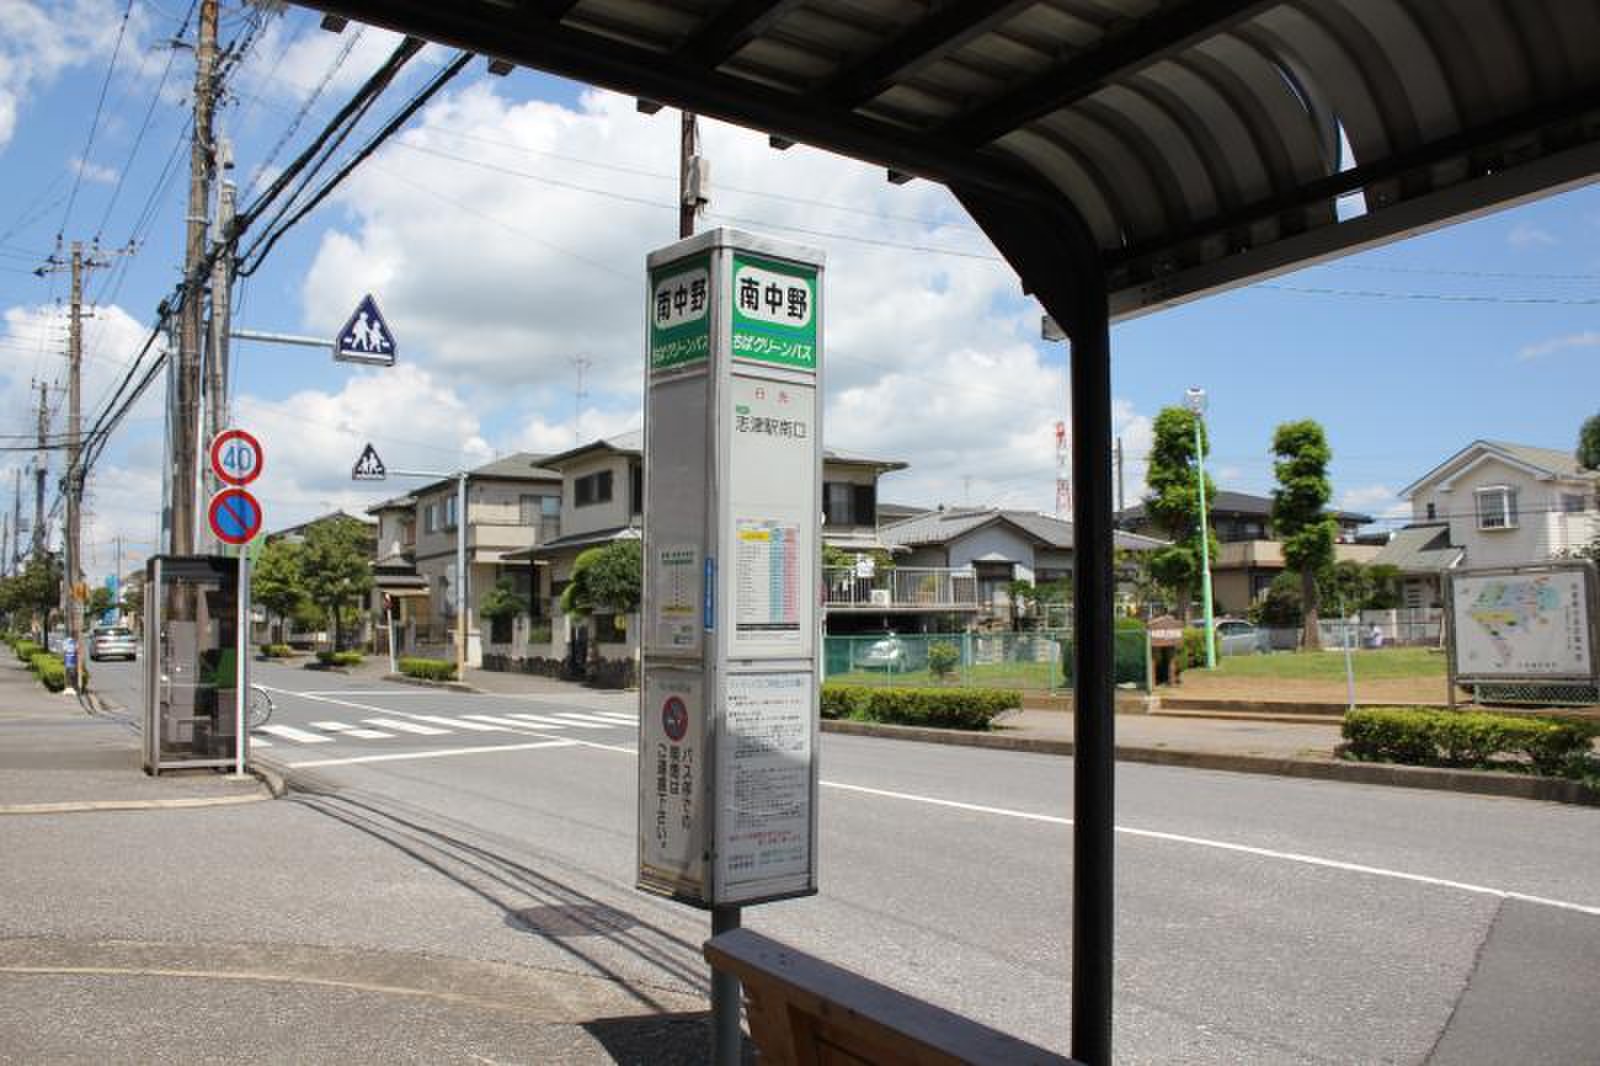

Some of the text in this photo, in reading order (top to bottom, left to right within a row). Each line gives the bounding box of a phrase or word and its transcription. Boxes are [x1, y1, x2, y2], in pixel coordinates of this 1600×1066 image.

[657, 278, 707, 321] 南中野
[739, 277, 808, 320] 南中野
[733, 333, 812, 362] ちばグリーンバス
[223, 446, 251, 471] 40
